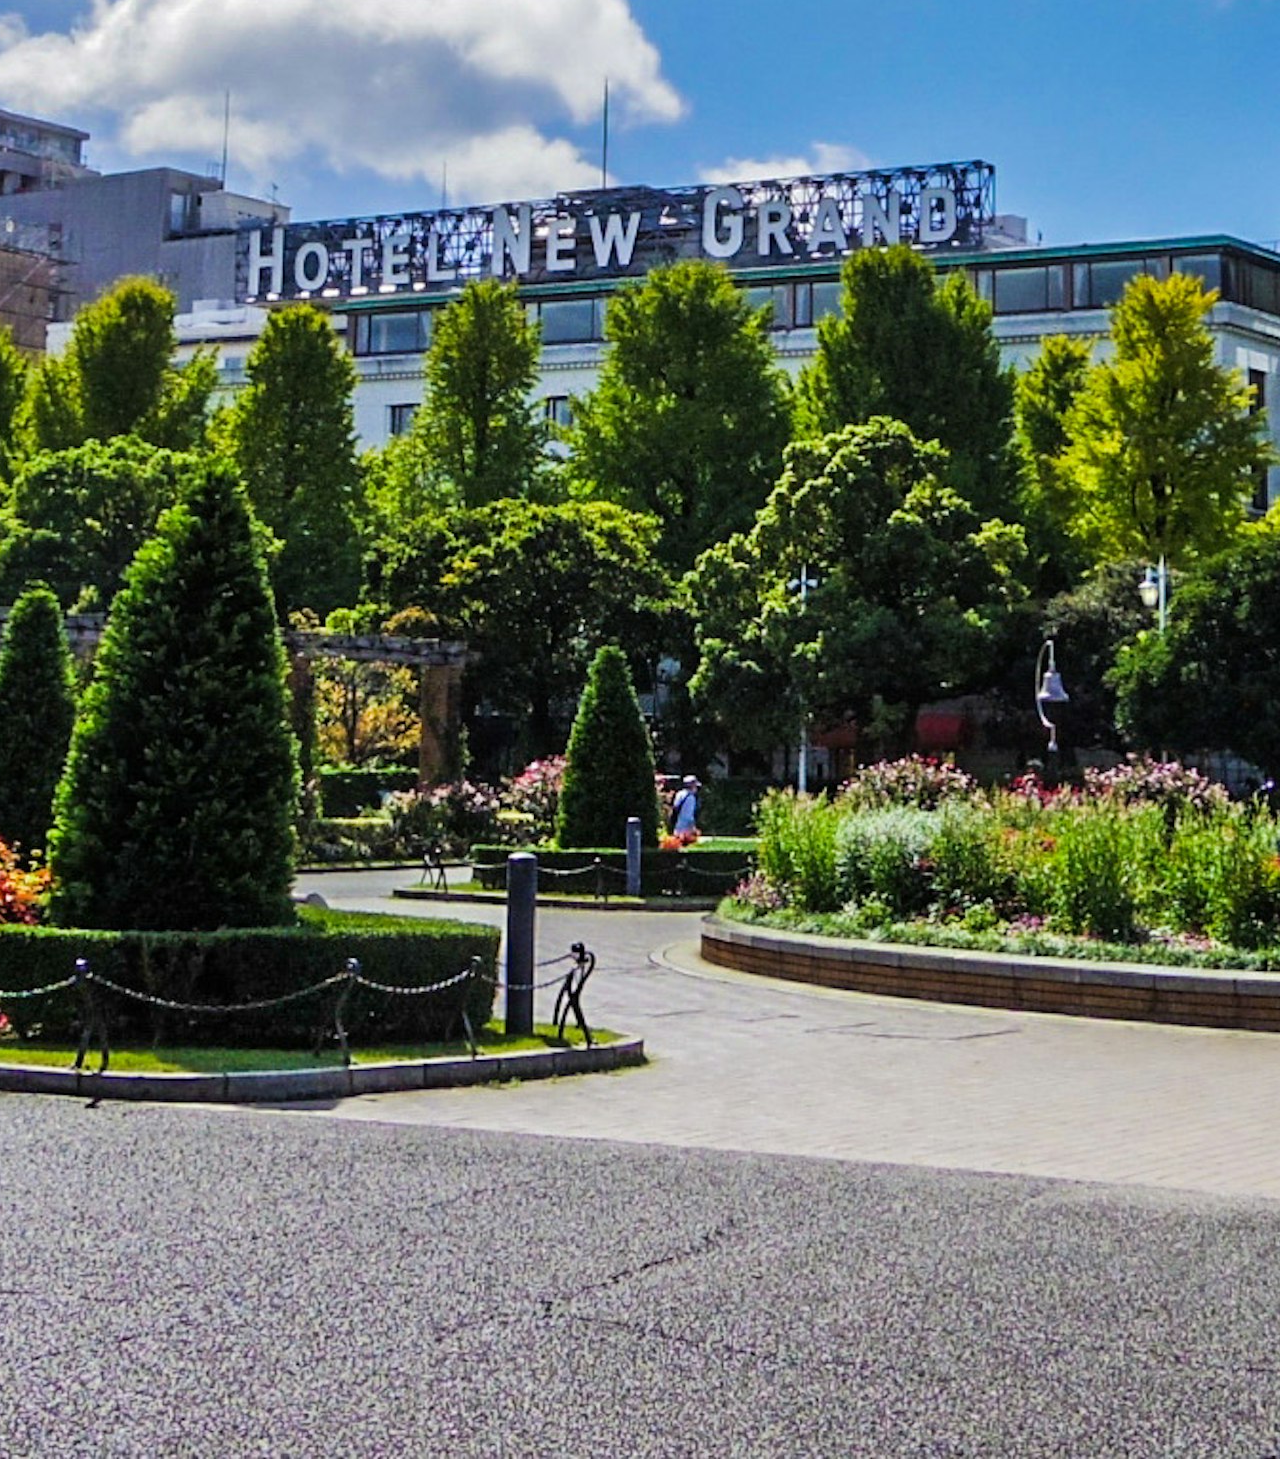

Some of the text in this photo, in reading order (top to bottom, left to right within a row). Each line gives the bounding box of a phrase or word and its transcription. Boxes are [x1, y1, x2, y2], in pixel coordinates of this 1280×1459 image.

[247, 185, 957, 296] HOTEL NEW GRAND
